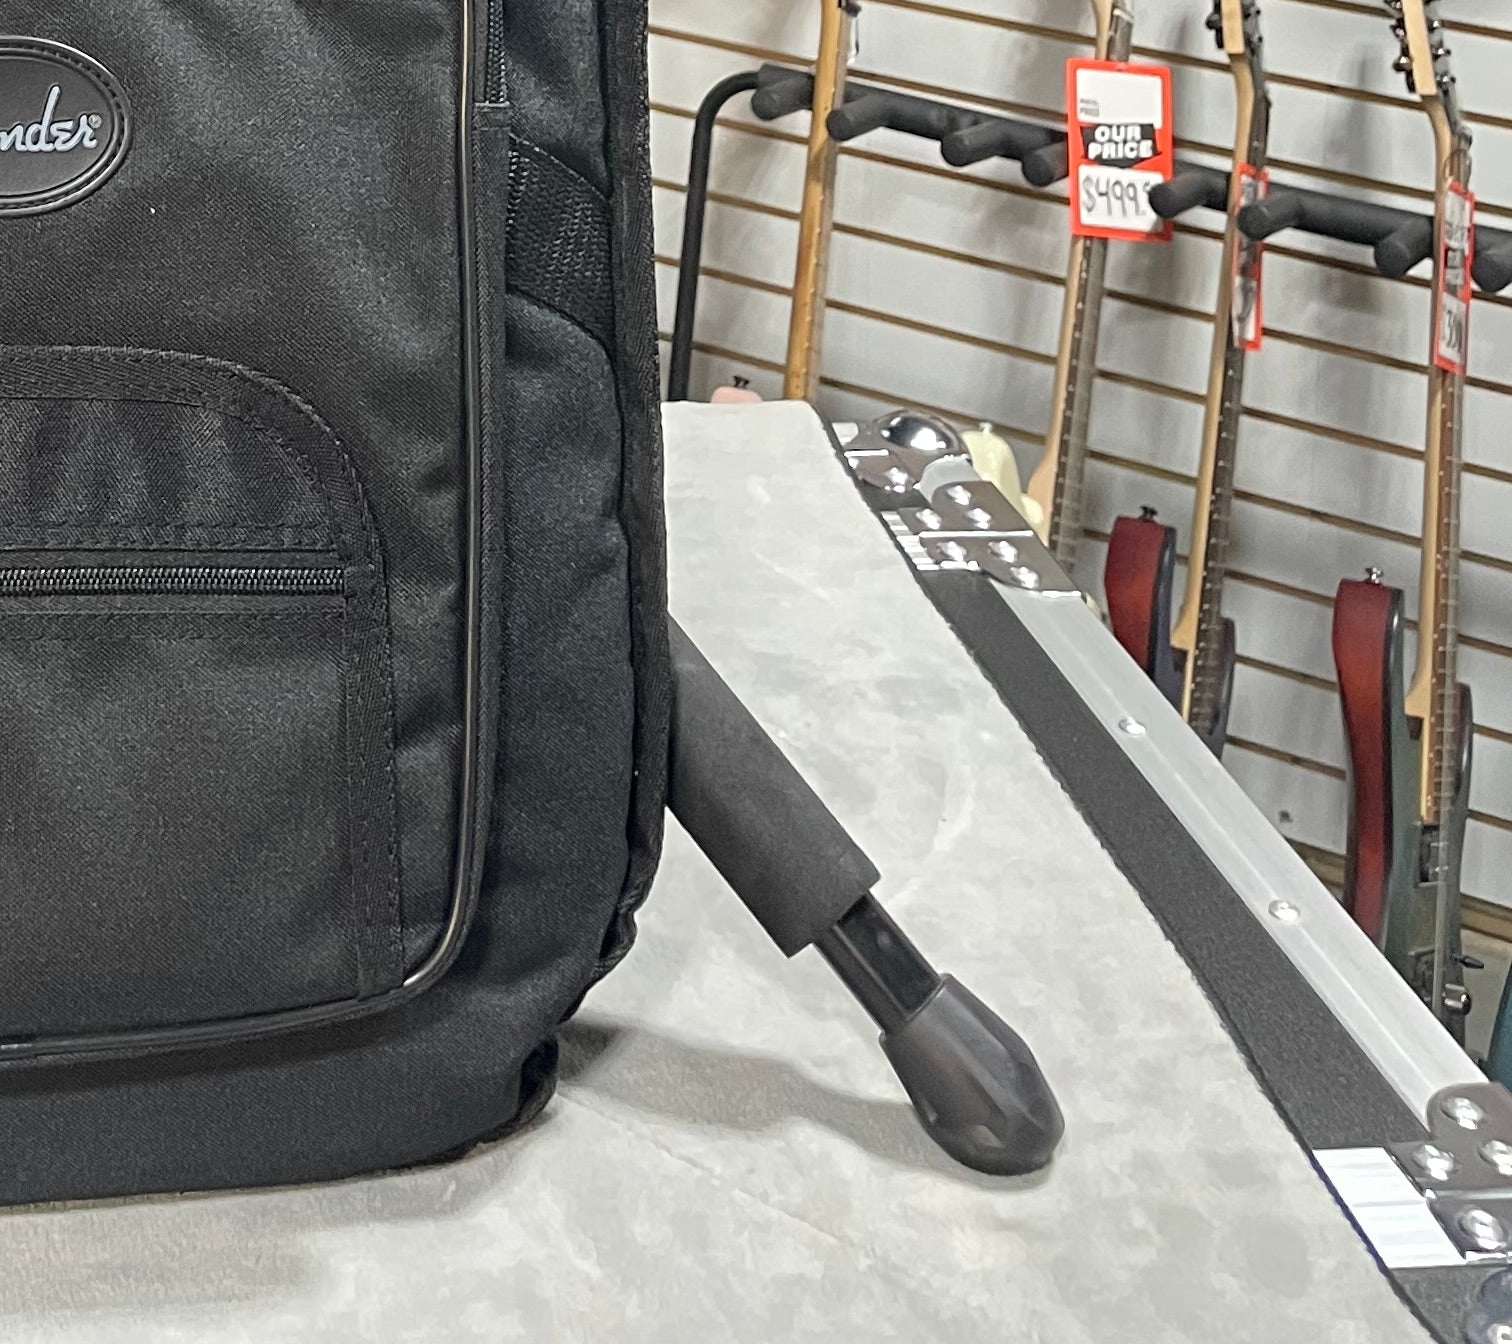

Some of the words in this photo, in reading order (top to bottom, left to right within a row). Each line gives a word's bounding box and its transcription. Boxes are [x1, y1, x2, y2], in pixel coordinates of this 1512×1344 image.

[1094, 125, 1142, 143] OUR
[1087, 139, 1154, 160] PRICE
[1081, 174, 1152, 218] $499.
